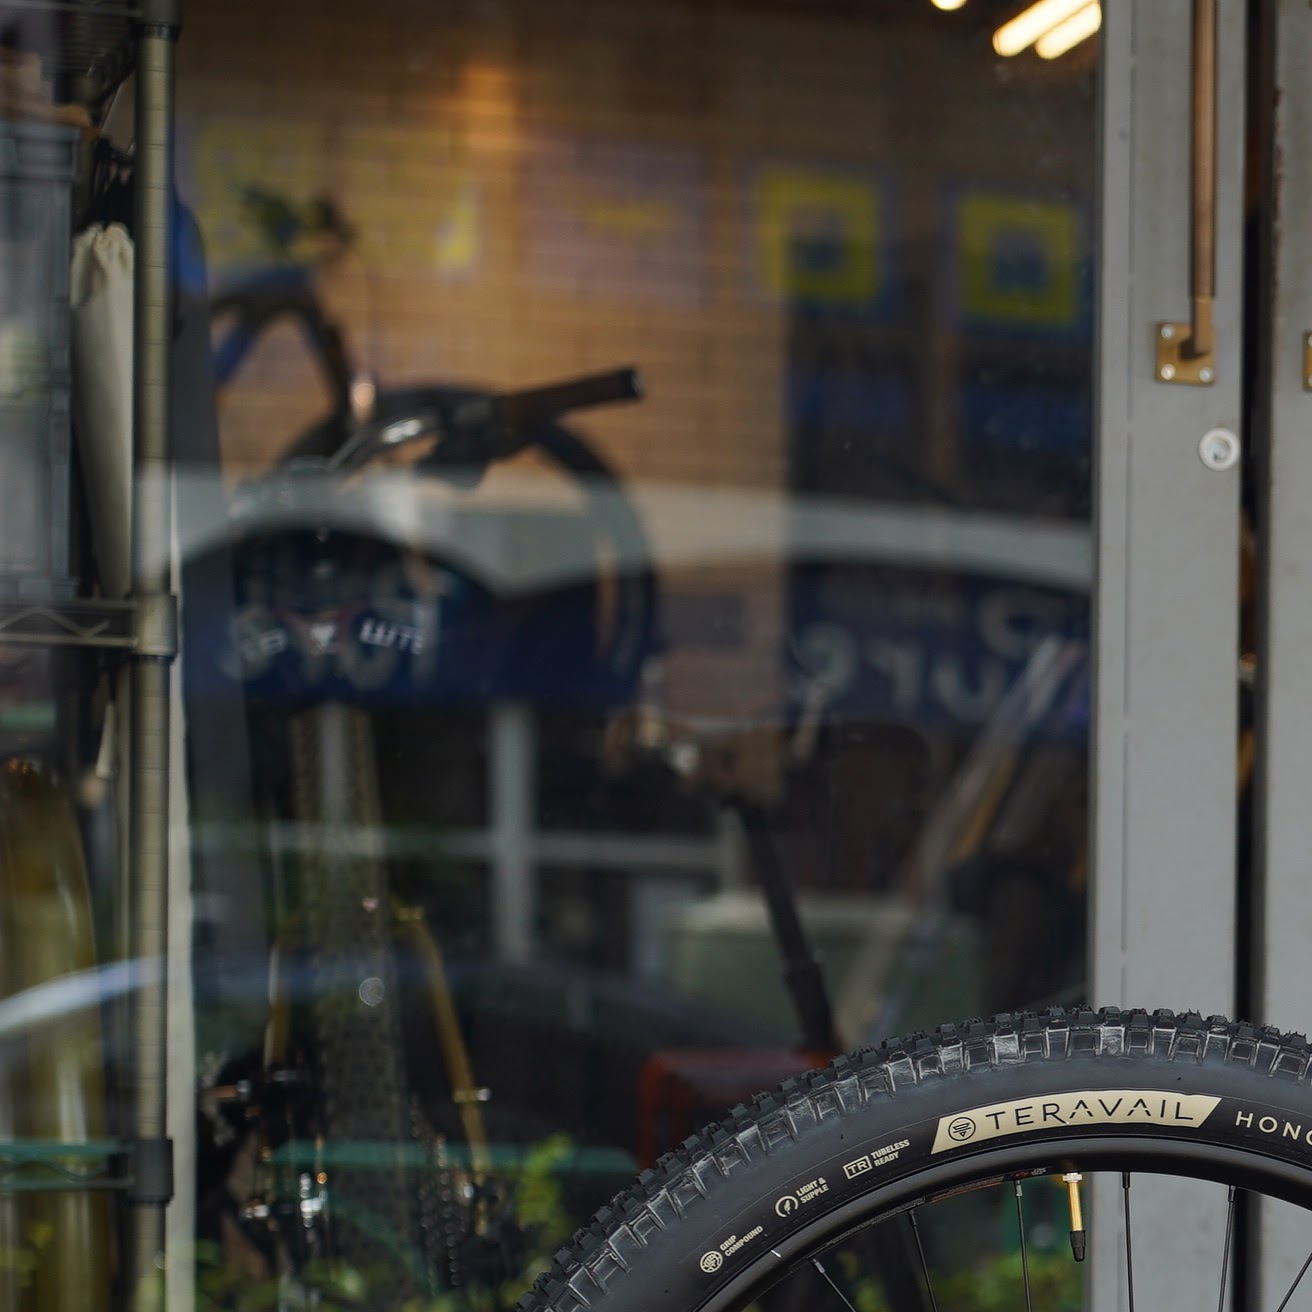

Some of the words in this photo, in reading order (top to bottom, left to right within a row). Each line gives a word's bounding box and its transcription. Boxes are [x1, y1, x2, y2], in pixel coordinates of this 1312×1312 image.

[986, 1098, 1194, 1130] TERAVAIL
[870, 1139, 910, 1159] TUBELESS
[874, 1151, 899, 1167] READY
[848, 1160, 868, 1174] TR
[796, 1180, 818, 1197] LIGHT
[818, 1177, 827, 1185] &
[800, 1184, 830, 1204] SUPPLE
[719, 1235, 737, 1251] GRIP
[724, 1225, 764, 1257] COMPOUND
